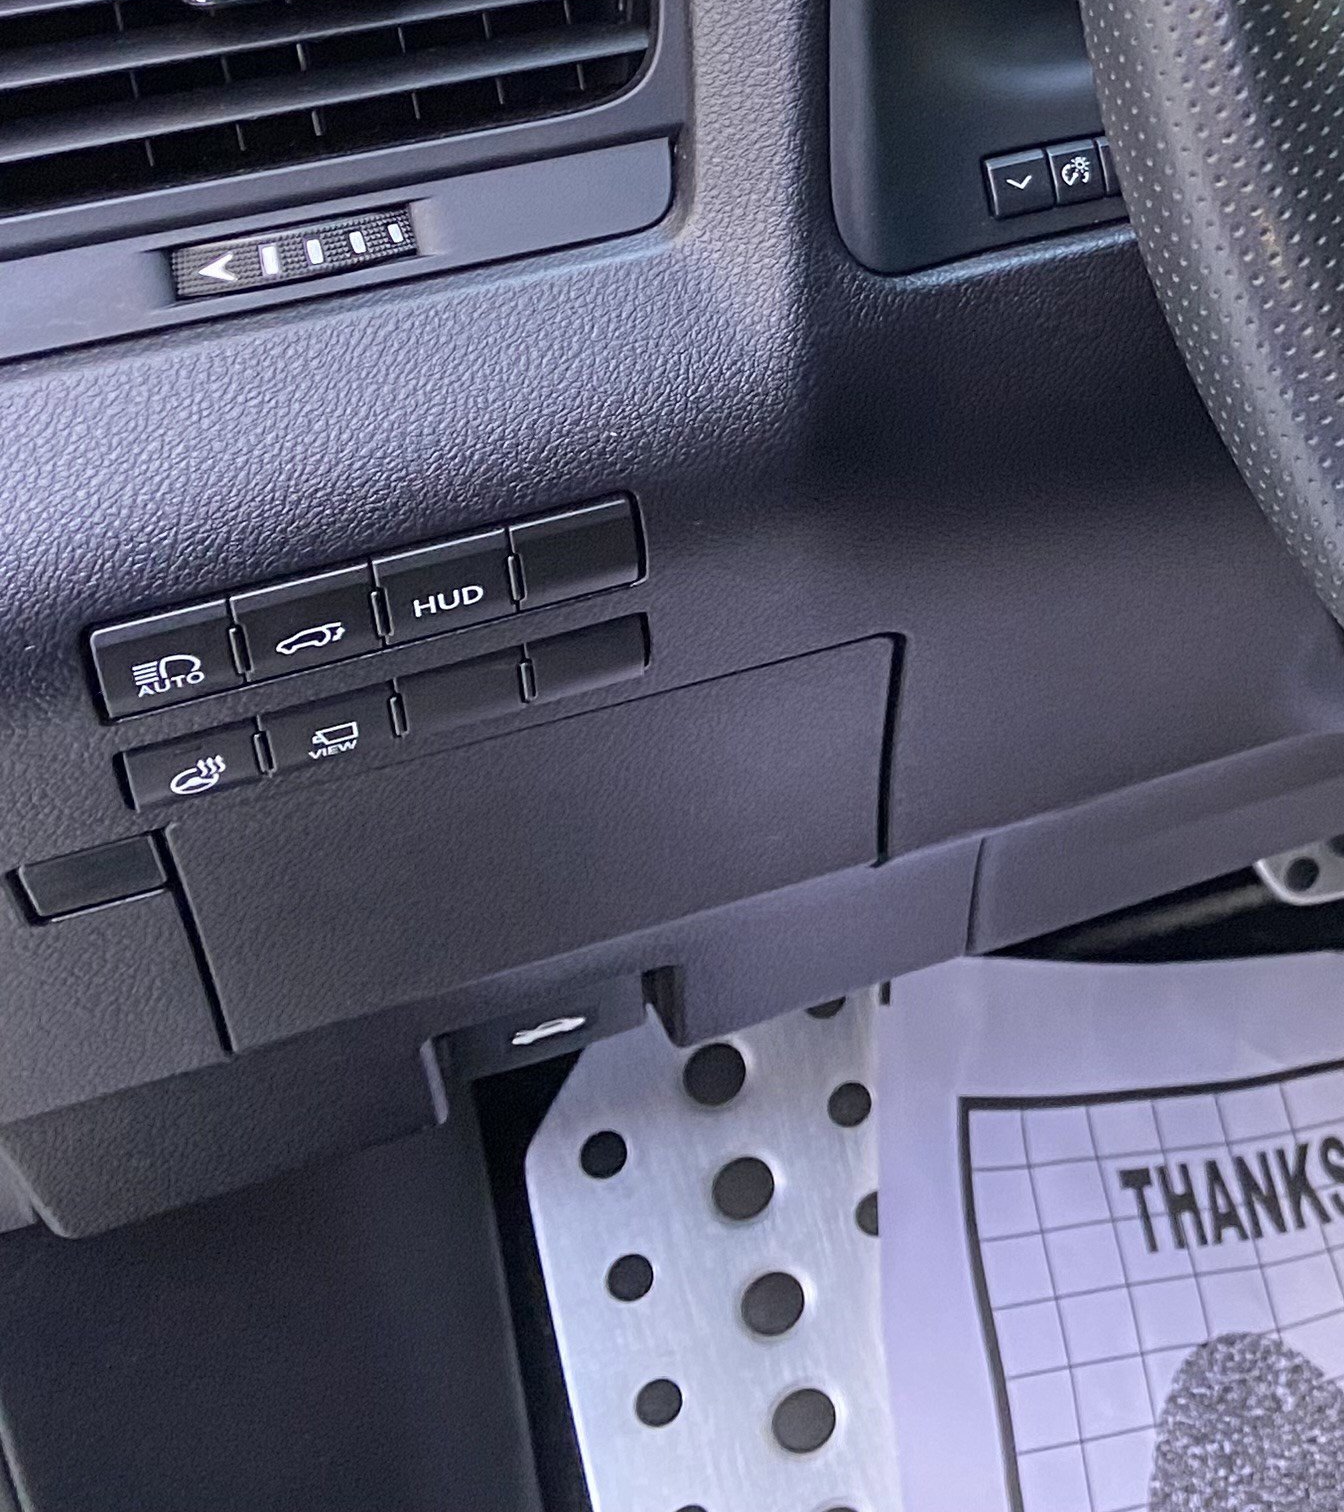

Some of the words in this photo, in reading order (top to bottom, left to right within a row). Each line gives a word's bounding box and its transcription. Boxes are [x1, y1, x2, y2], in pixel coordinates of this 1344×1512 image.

[412, 585, 484, 618] HUD
[137, 670, 205, 698] AUTO
[308, 739, 358, 760] VIEW
